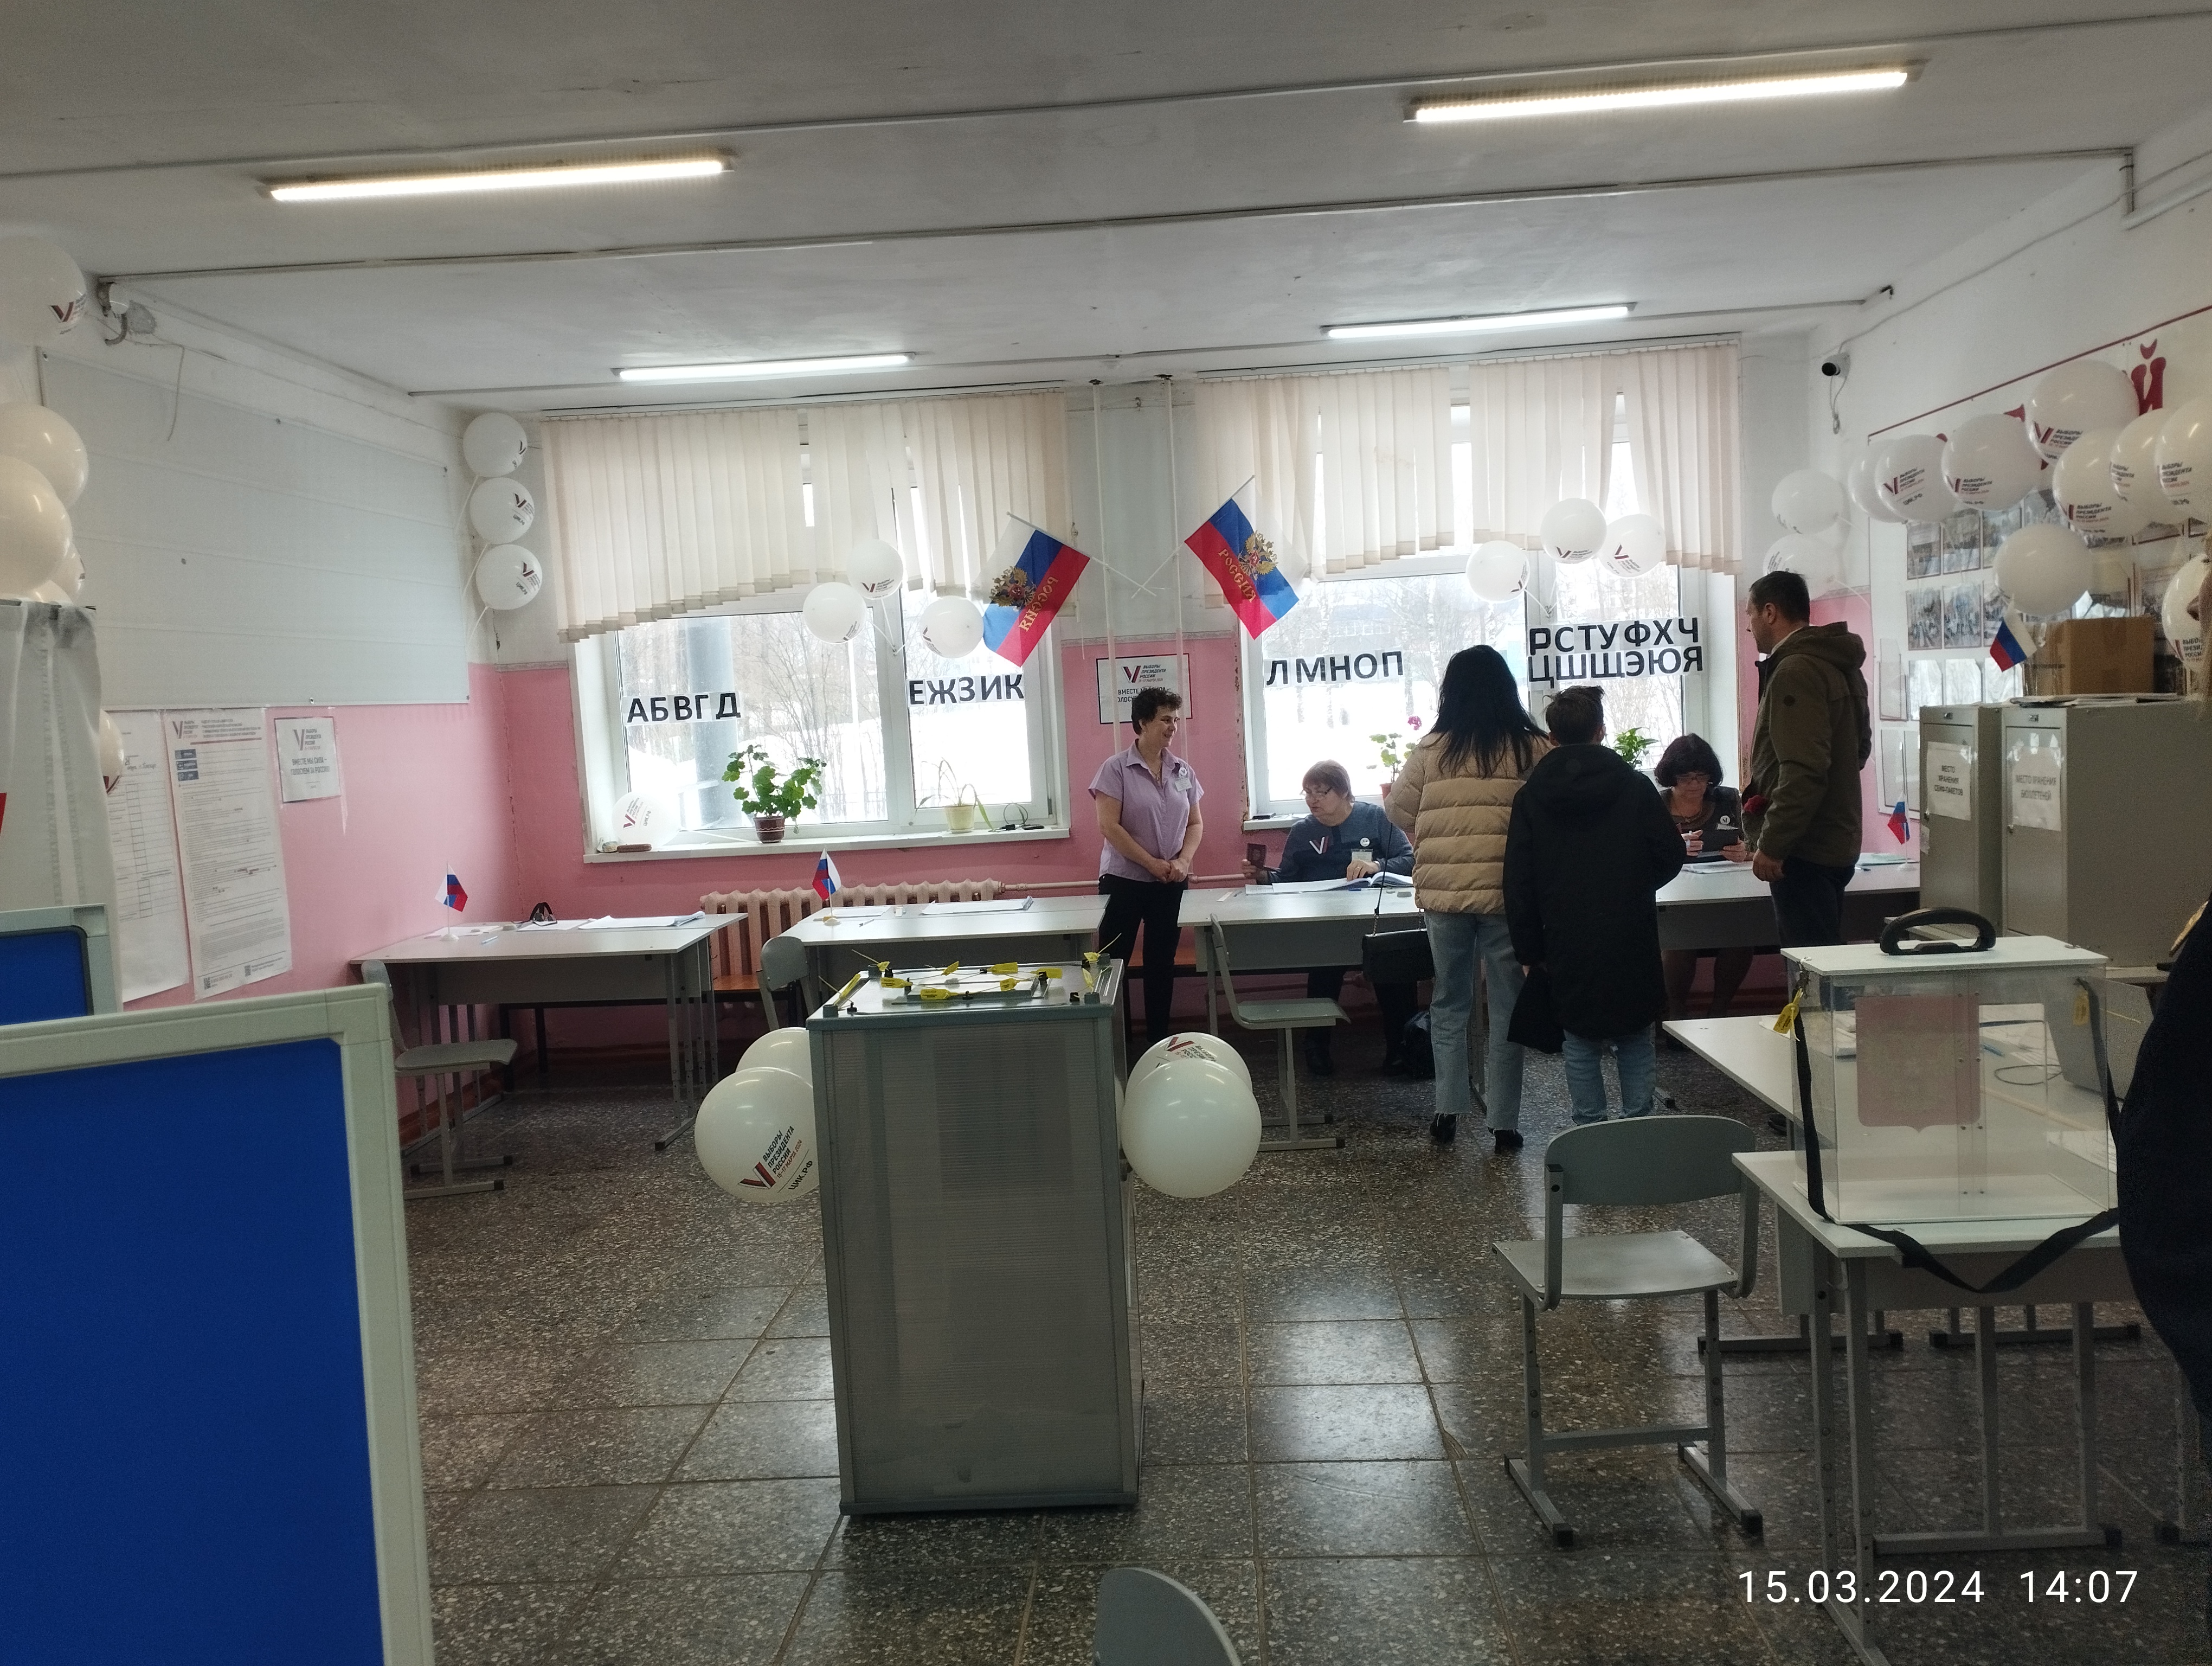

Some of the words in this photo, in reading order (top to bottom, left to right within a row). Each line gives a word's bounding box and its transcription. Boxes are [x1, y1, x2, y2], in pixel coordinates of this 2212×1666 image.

[1218, 549, 1256, 603] РОССИЯ
[1529, 617, 1698, 655] РСТУФХЧ
[1266, 651, 1403, 685] ЛМНОП
[1528, 646, 1703, 689] ЦШЩЭЮЯ
[909, 674, 1024, 705] ЕЖЗИК
[627, 693, 741, 723] АБВГД
[763, 1130, 783, 1162] ВЫБОРЫ
[767, 1126, 794, 1168] ПРЕЗИДЕНТА
[773, 1148, 791, 1174] РОССИИ
[786, 1151, 797, 1168] МАРТА
[788, 1161, 813, 1189] ЦИК.РФ
